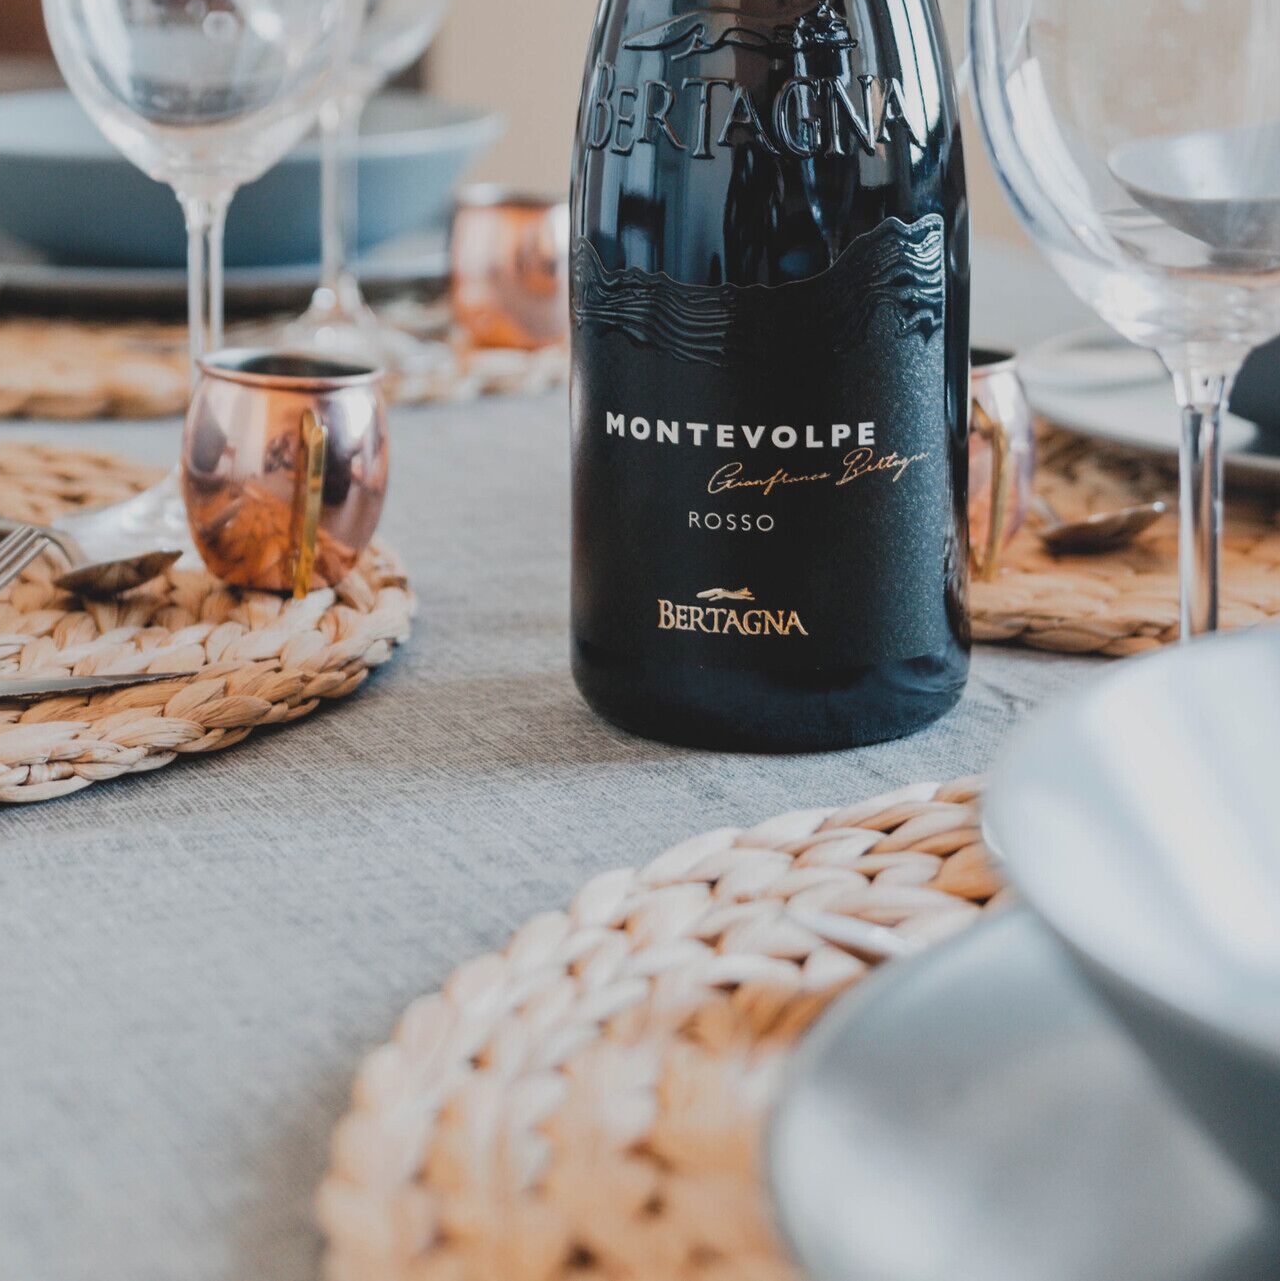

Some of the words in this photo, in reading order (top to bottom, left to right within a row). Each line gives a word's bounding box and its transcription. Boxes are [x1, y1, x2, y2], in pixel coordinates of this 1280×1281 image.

[587, 61, 926, 160] BERTAGNA
[606, 411, 876, 449] MONTEVOLPE
[688, 511, 774, 532] ROSSO
[656, 599, 808, 636] BERTAGNA
